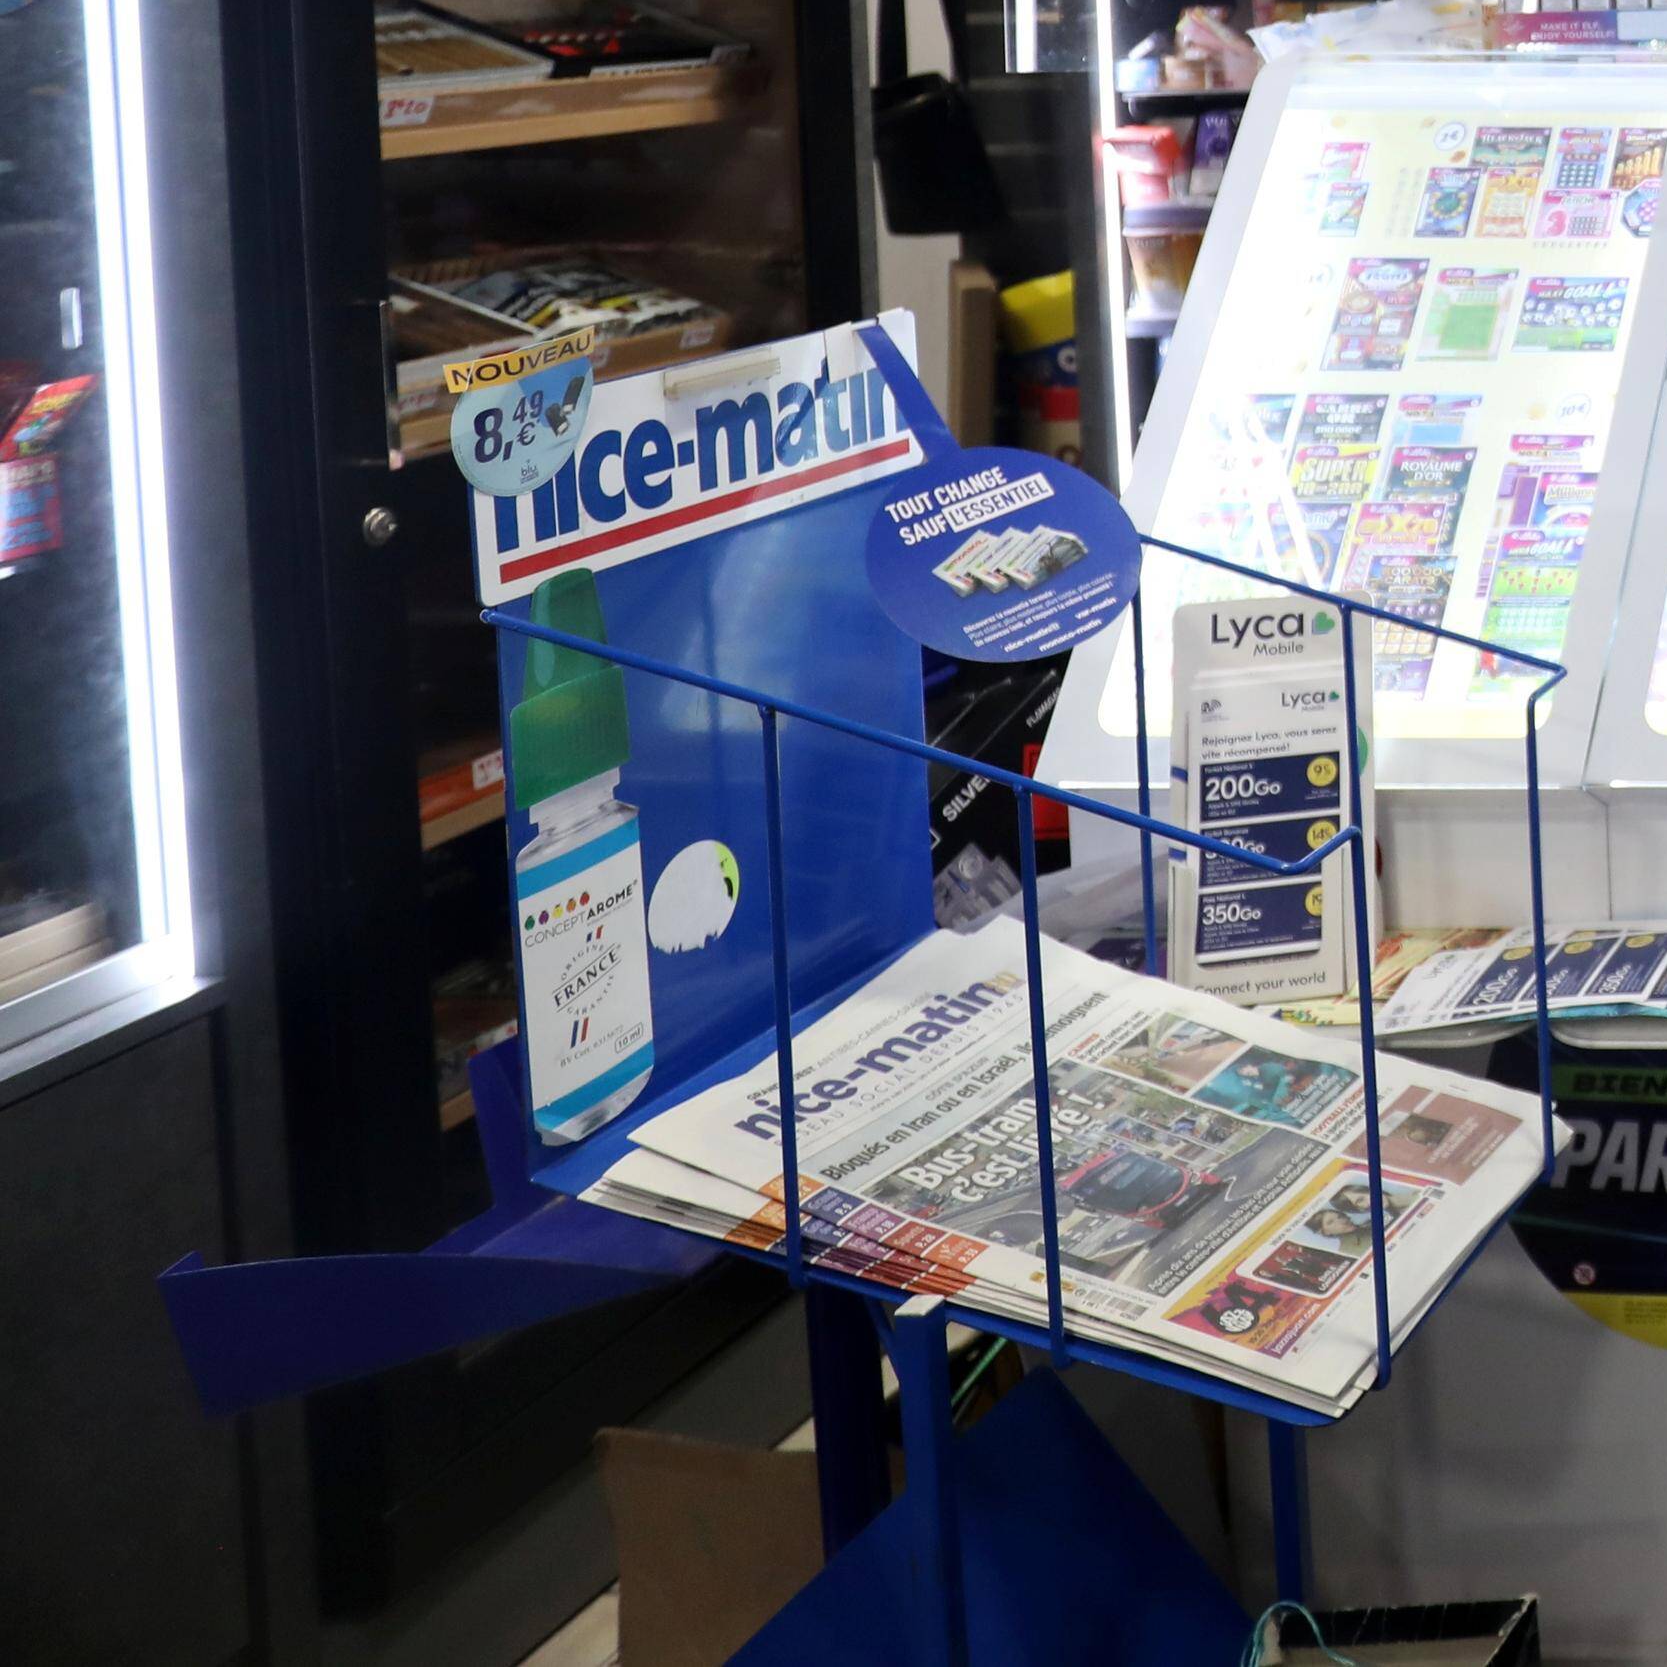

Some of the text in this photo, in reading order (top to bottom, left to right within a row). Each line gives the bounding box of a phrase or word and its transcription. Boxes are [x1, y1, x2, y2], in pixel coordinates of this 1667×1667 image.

[451, 334, 592, 385] NOUVEAU
[885, 465, 1008, 524] TOUT CHANGE
[899, 479, 1050, 546] SAUF L'ESSENTIEL
[1211, 612, 1304, 649] Lyca
[1253, 641, 1304, 657] Mobile
[1281, 690, 1326, 709] Lyca
[1201, 726, 1337, 748] Rejoignez Lyca, vous serez
[1201, 743, 1290, 761] vite récompensé!
[1205, 774, 1281, 802] 200Go
[1202, 903, 1262, 925] 350Go
[553, 949, 619, 1007] FRANCE
[1195, 972, 1326, 996] Connect your world
[818, 1142, 891, 1183] Bloqués
[887, 1123, 911, 1146] en
[910, 1108, 940, 1133] Iran
[936, 1095, 962, 1116] ou
[956, 1081, 981, 1102] en
[979, 1051, 1026, 1091] Israël,
[1046, 989, 1110, 1043] moignent
[900, 1094, 1037, 1191] Bus-tram
[950, 1148, 1021, 1204] c'est
